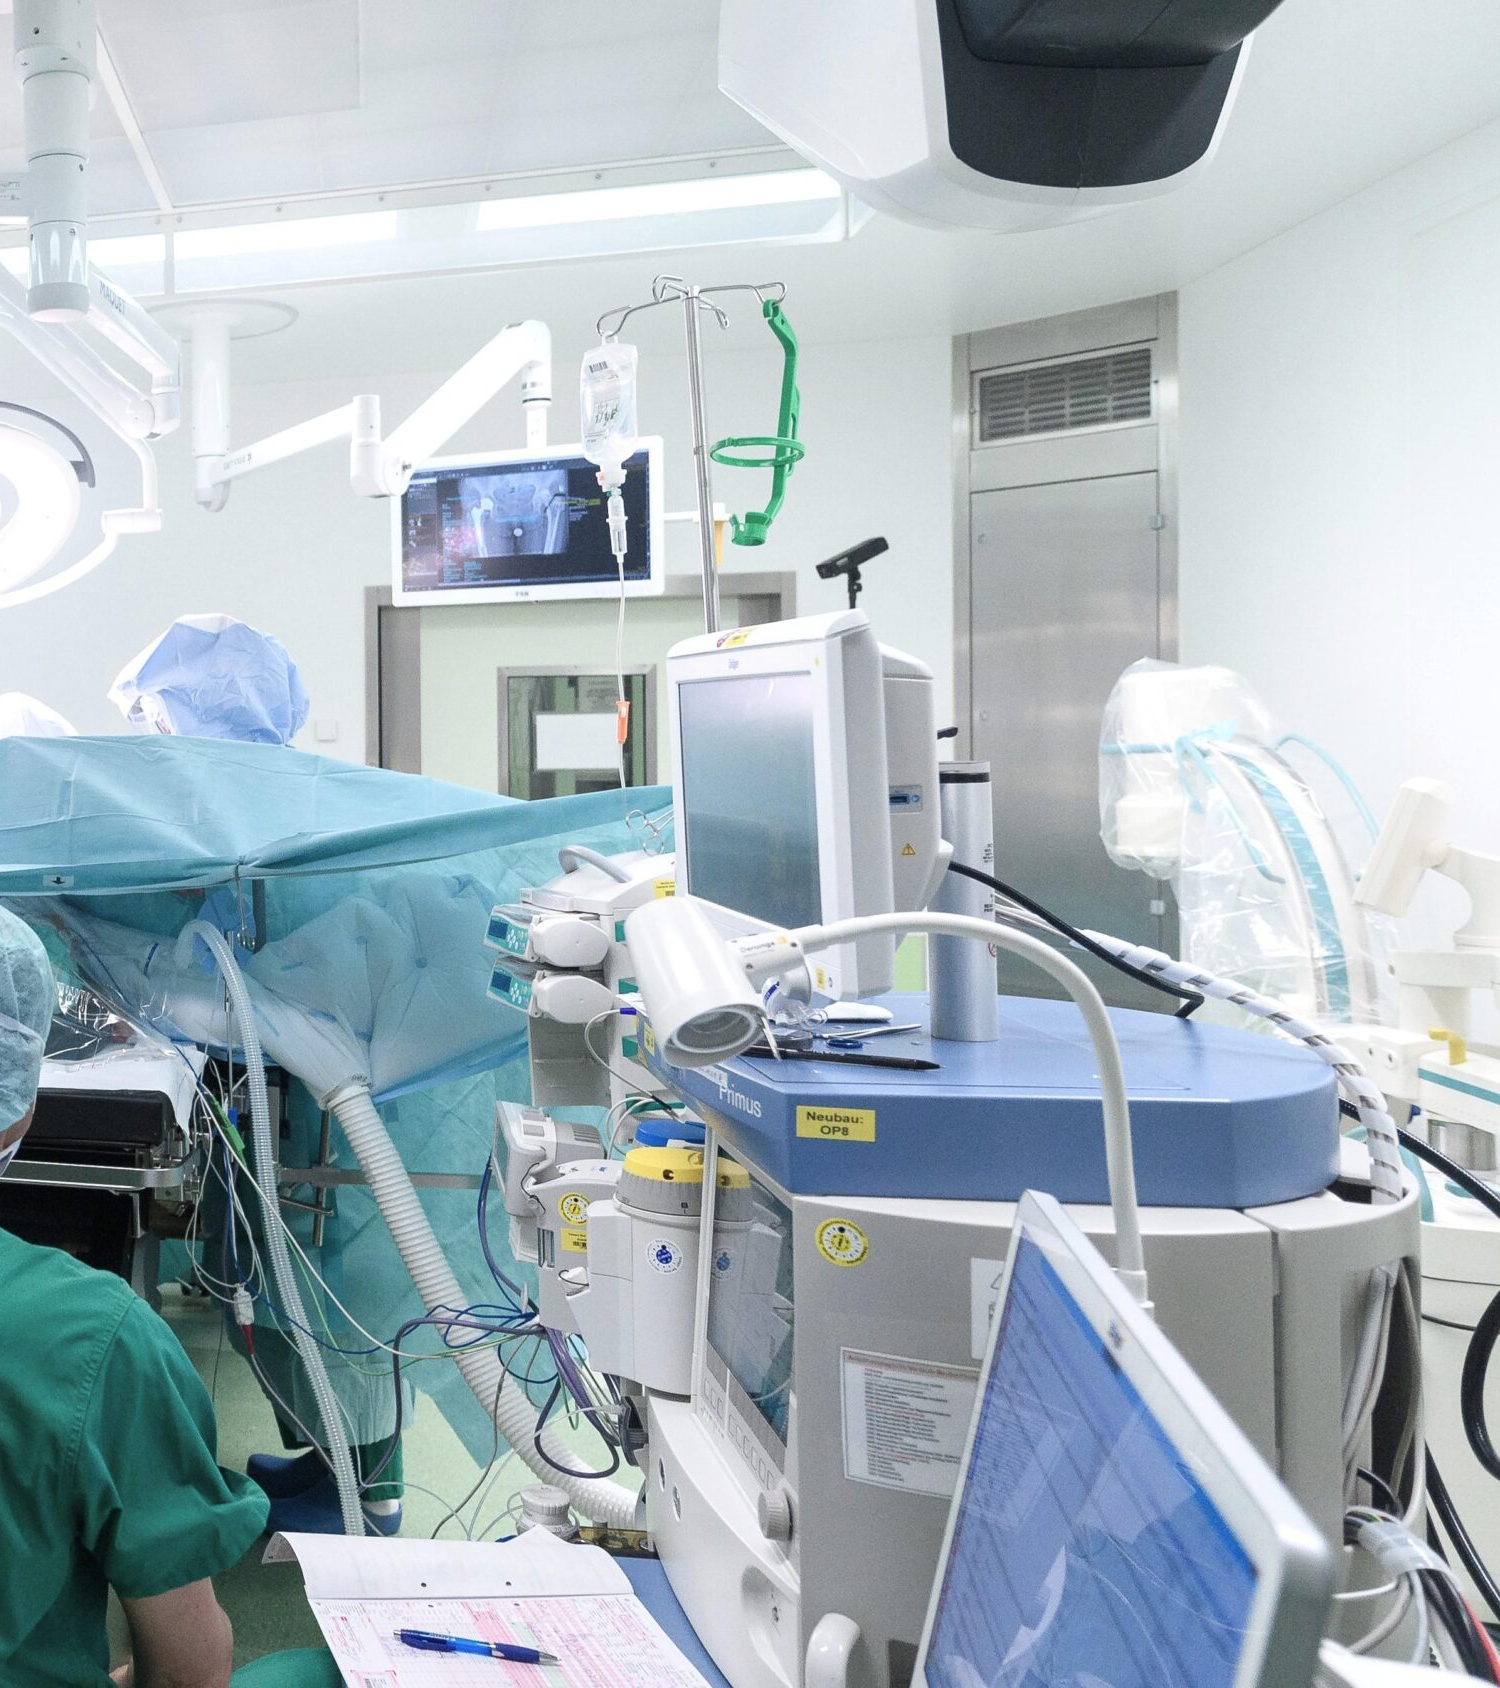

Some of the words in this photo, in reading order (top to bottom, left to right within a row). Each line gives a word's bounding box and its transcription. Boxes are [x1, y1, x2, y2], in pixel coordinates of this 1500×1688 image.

[719, 1083, 762, 1118] Primus
[805, 1111, 864, 1124] Neubau:
[820, 1125, 850, 1136] OP8
